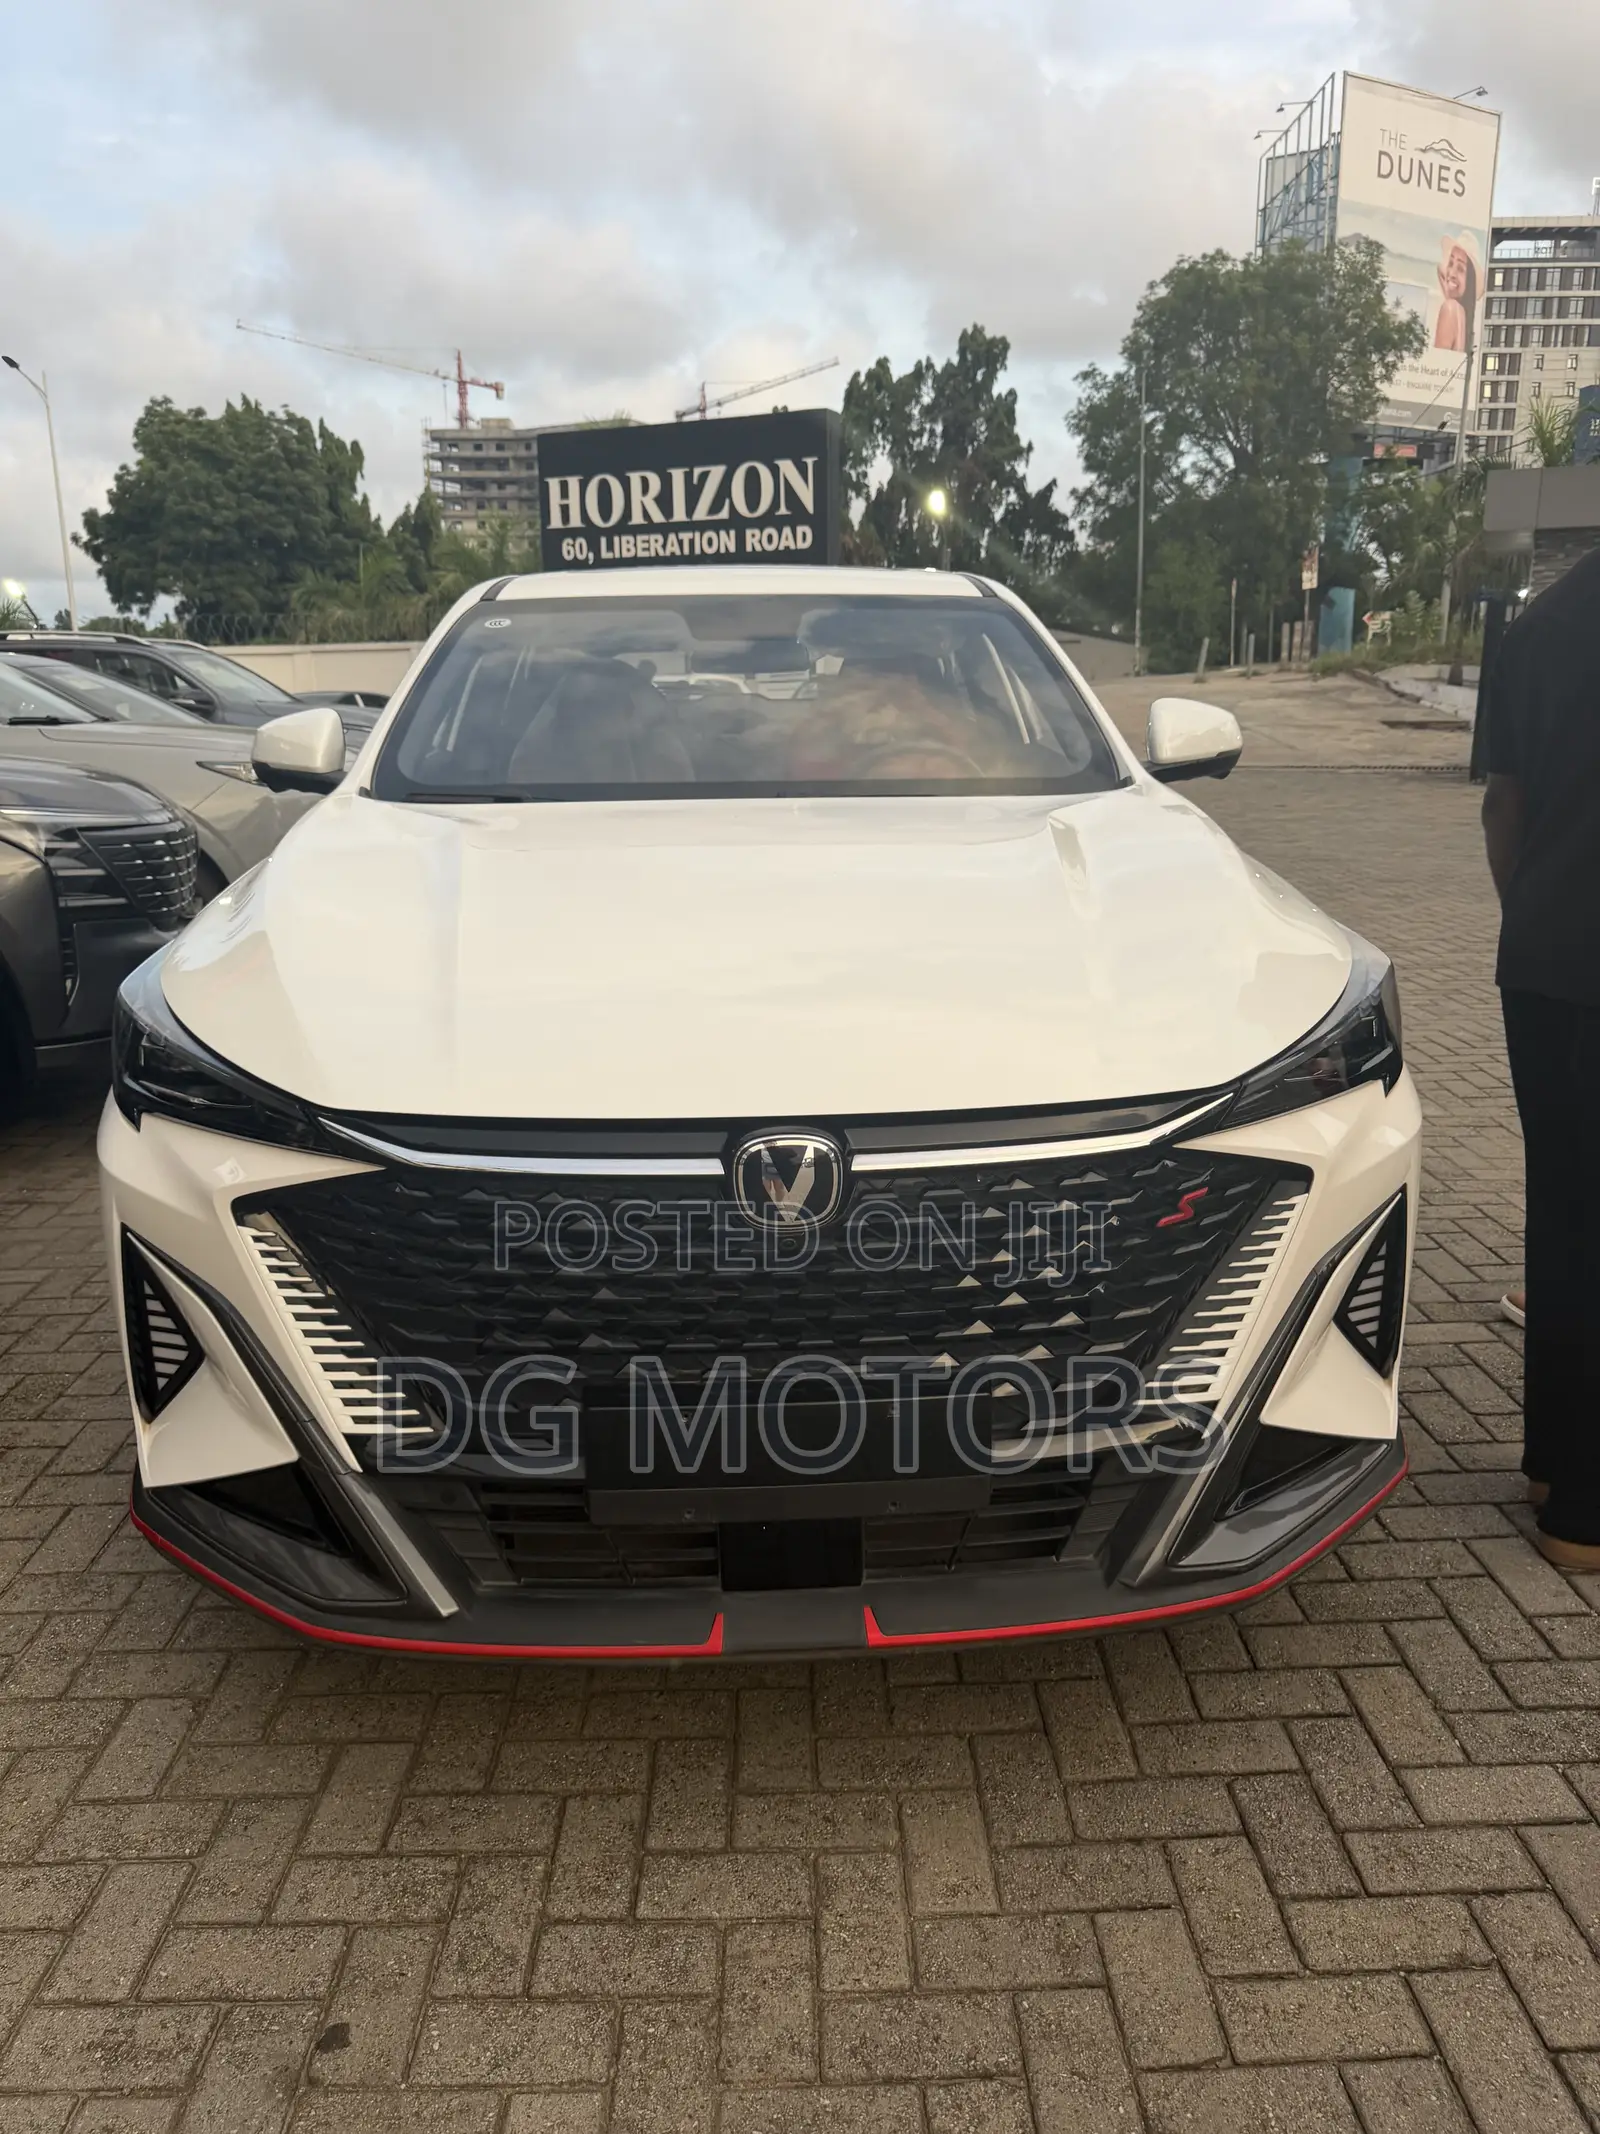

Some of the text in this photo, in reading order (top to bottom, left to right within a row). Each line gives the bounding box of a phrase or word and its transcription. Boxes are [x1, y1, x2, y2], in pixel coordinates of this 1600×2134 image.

[1380, 128, 1408, 150] THE
[1377, 150, 1466, 198] DUNES
[544, 456, 818, 530] HORIZON
[561, 525, 813, 565] 60, LIBERATION ROAD
